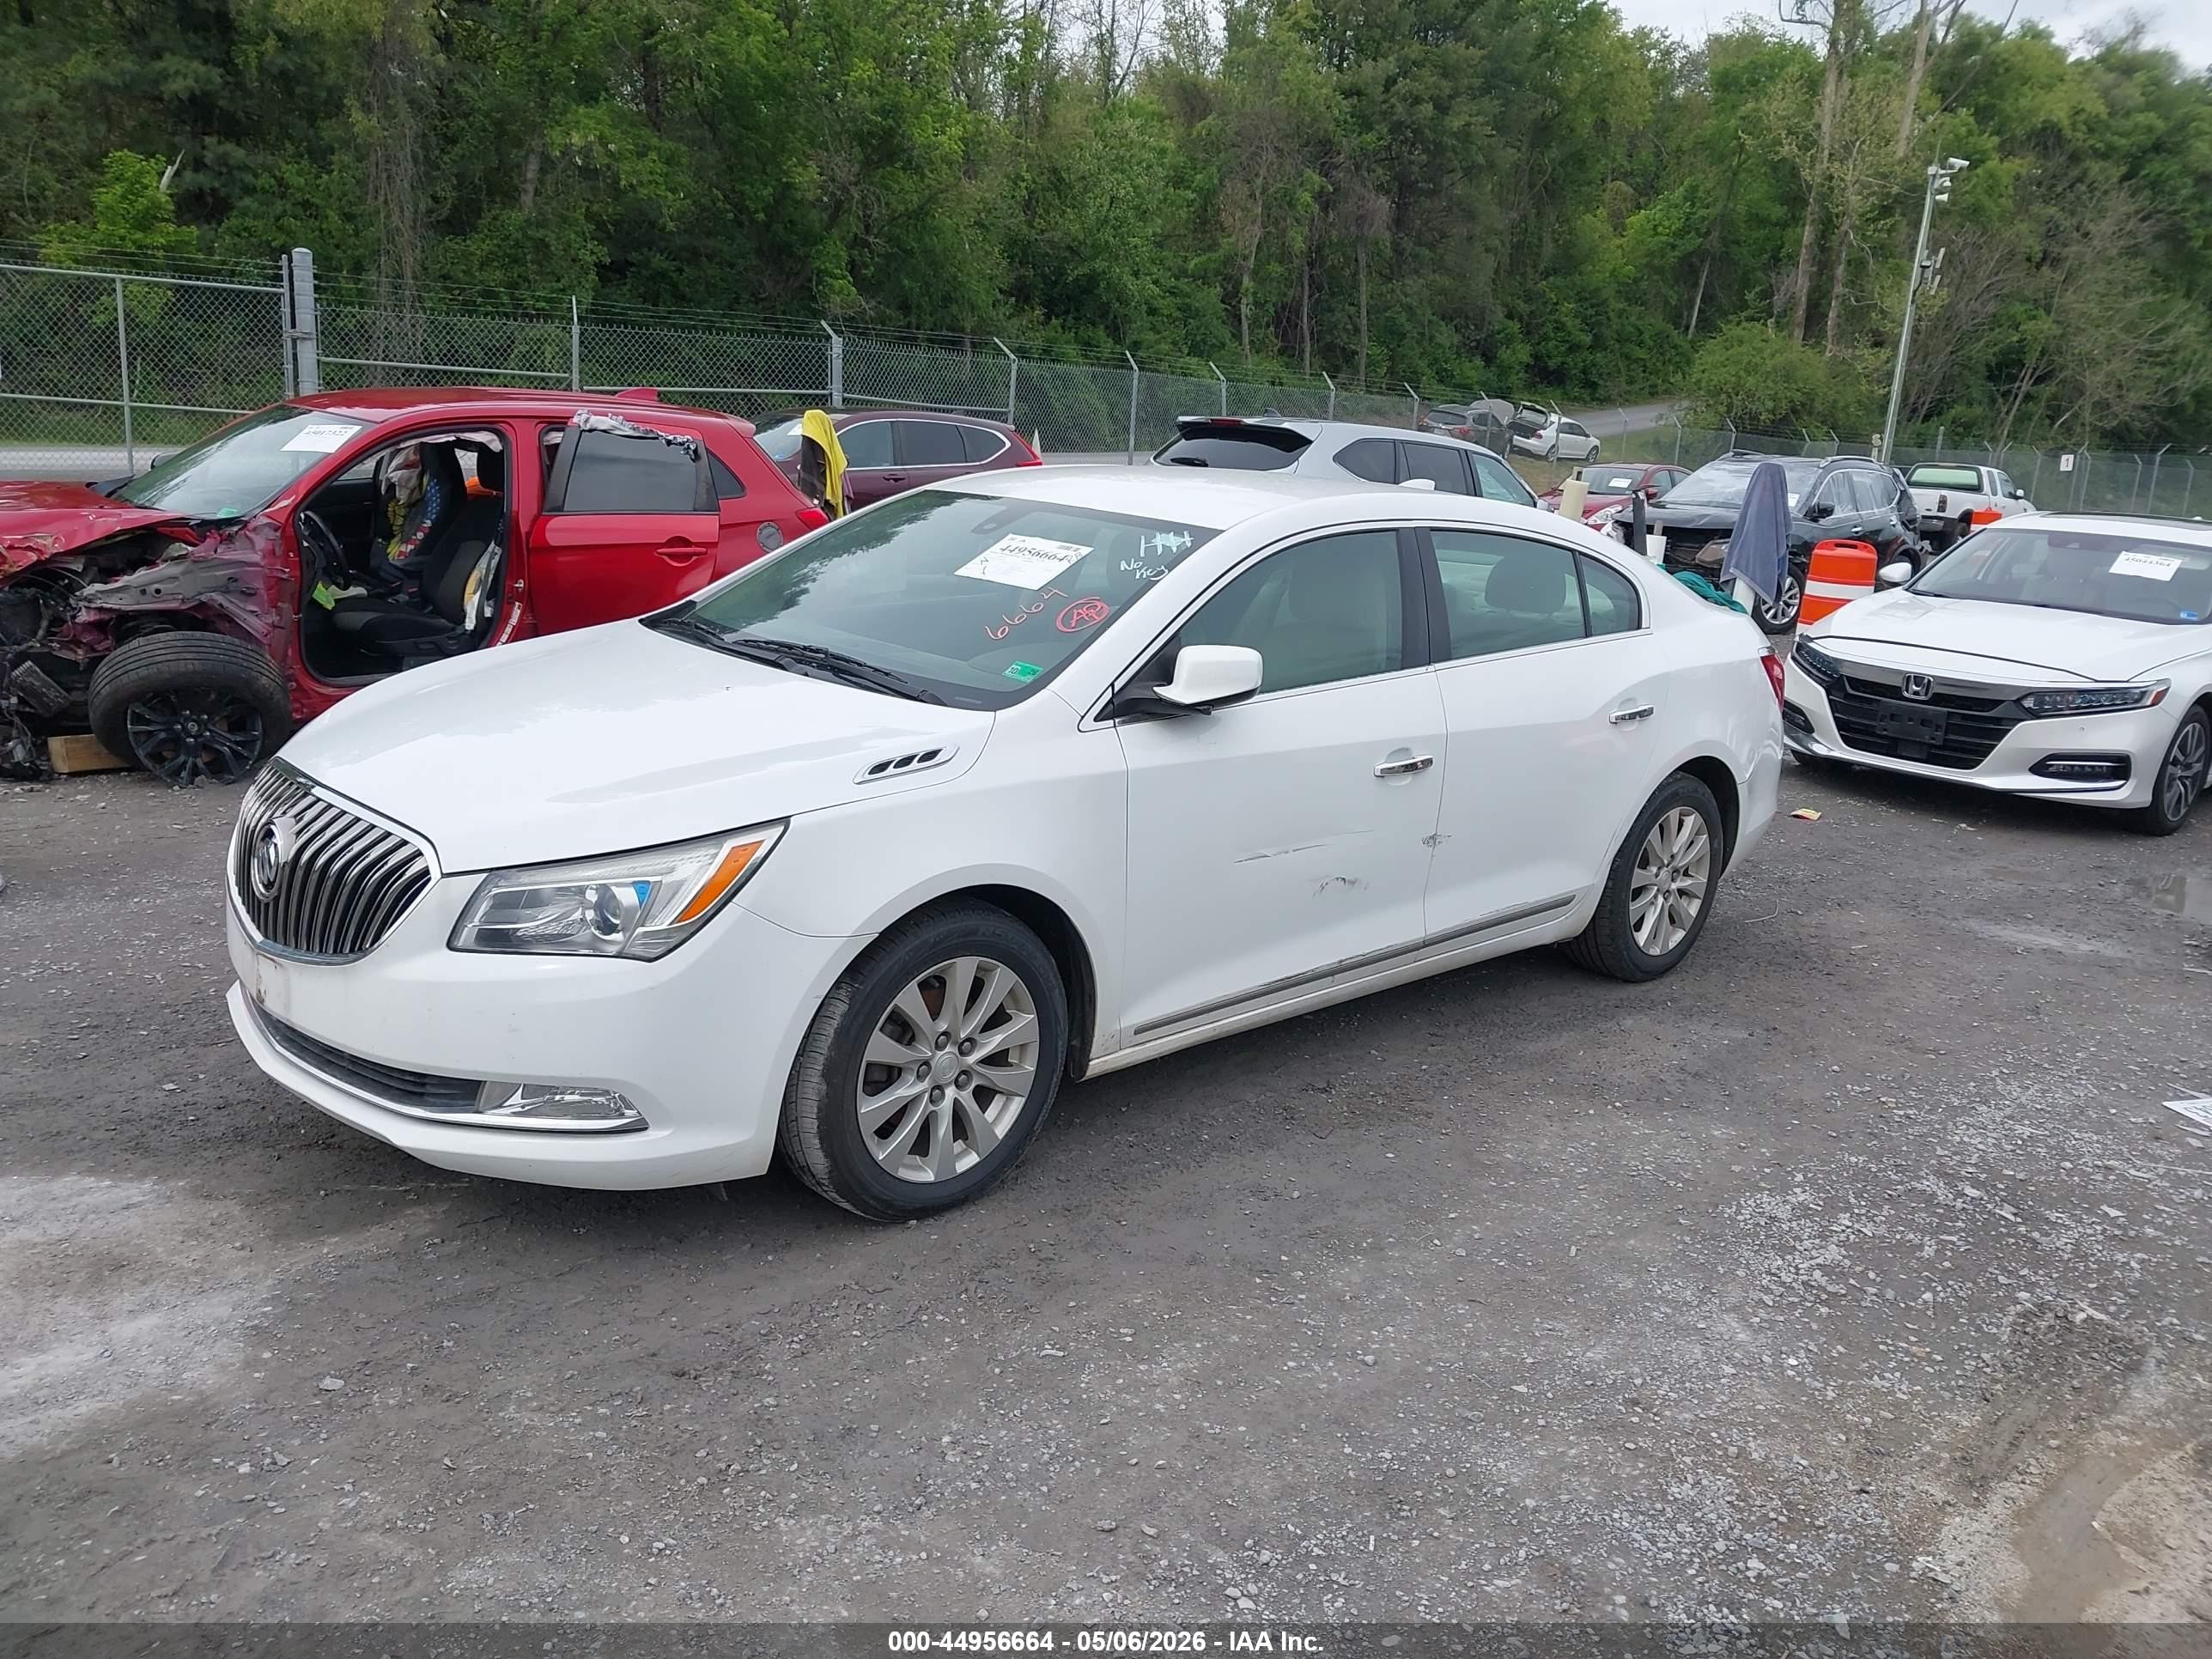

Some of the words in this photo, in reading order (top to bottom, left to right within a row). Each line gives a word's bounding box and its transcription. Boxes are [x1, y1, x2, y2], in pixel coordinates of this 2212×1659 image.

[999, 544, 1068, 563] 44956664
[1120, 557, 1144, 571] No
[984, 586, 1069, 640] 6664
[1008, 666, 1019, 675] 10
